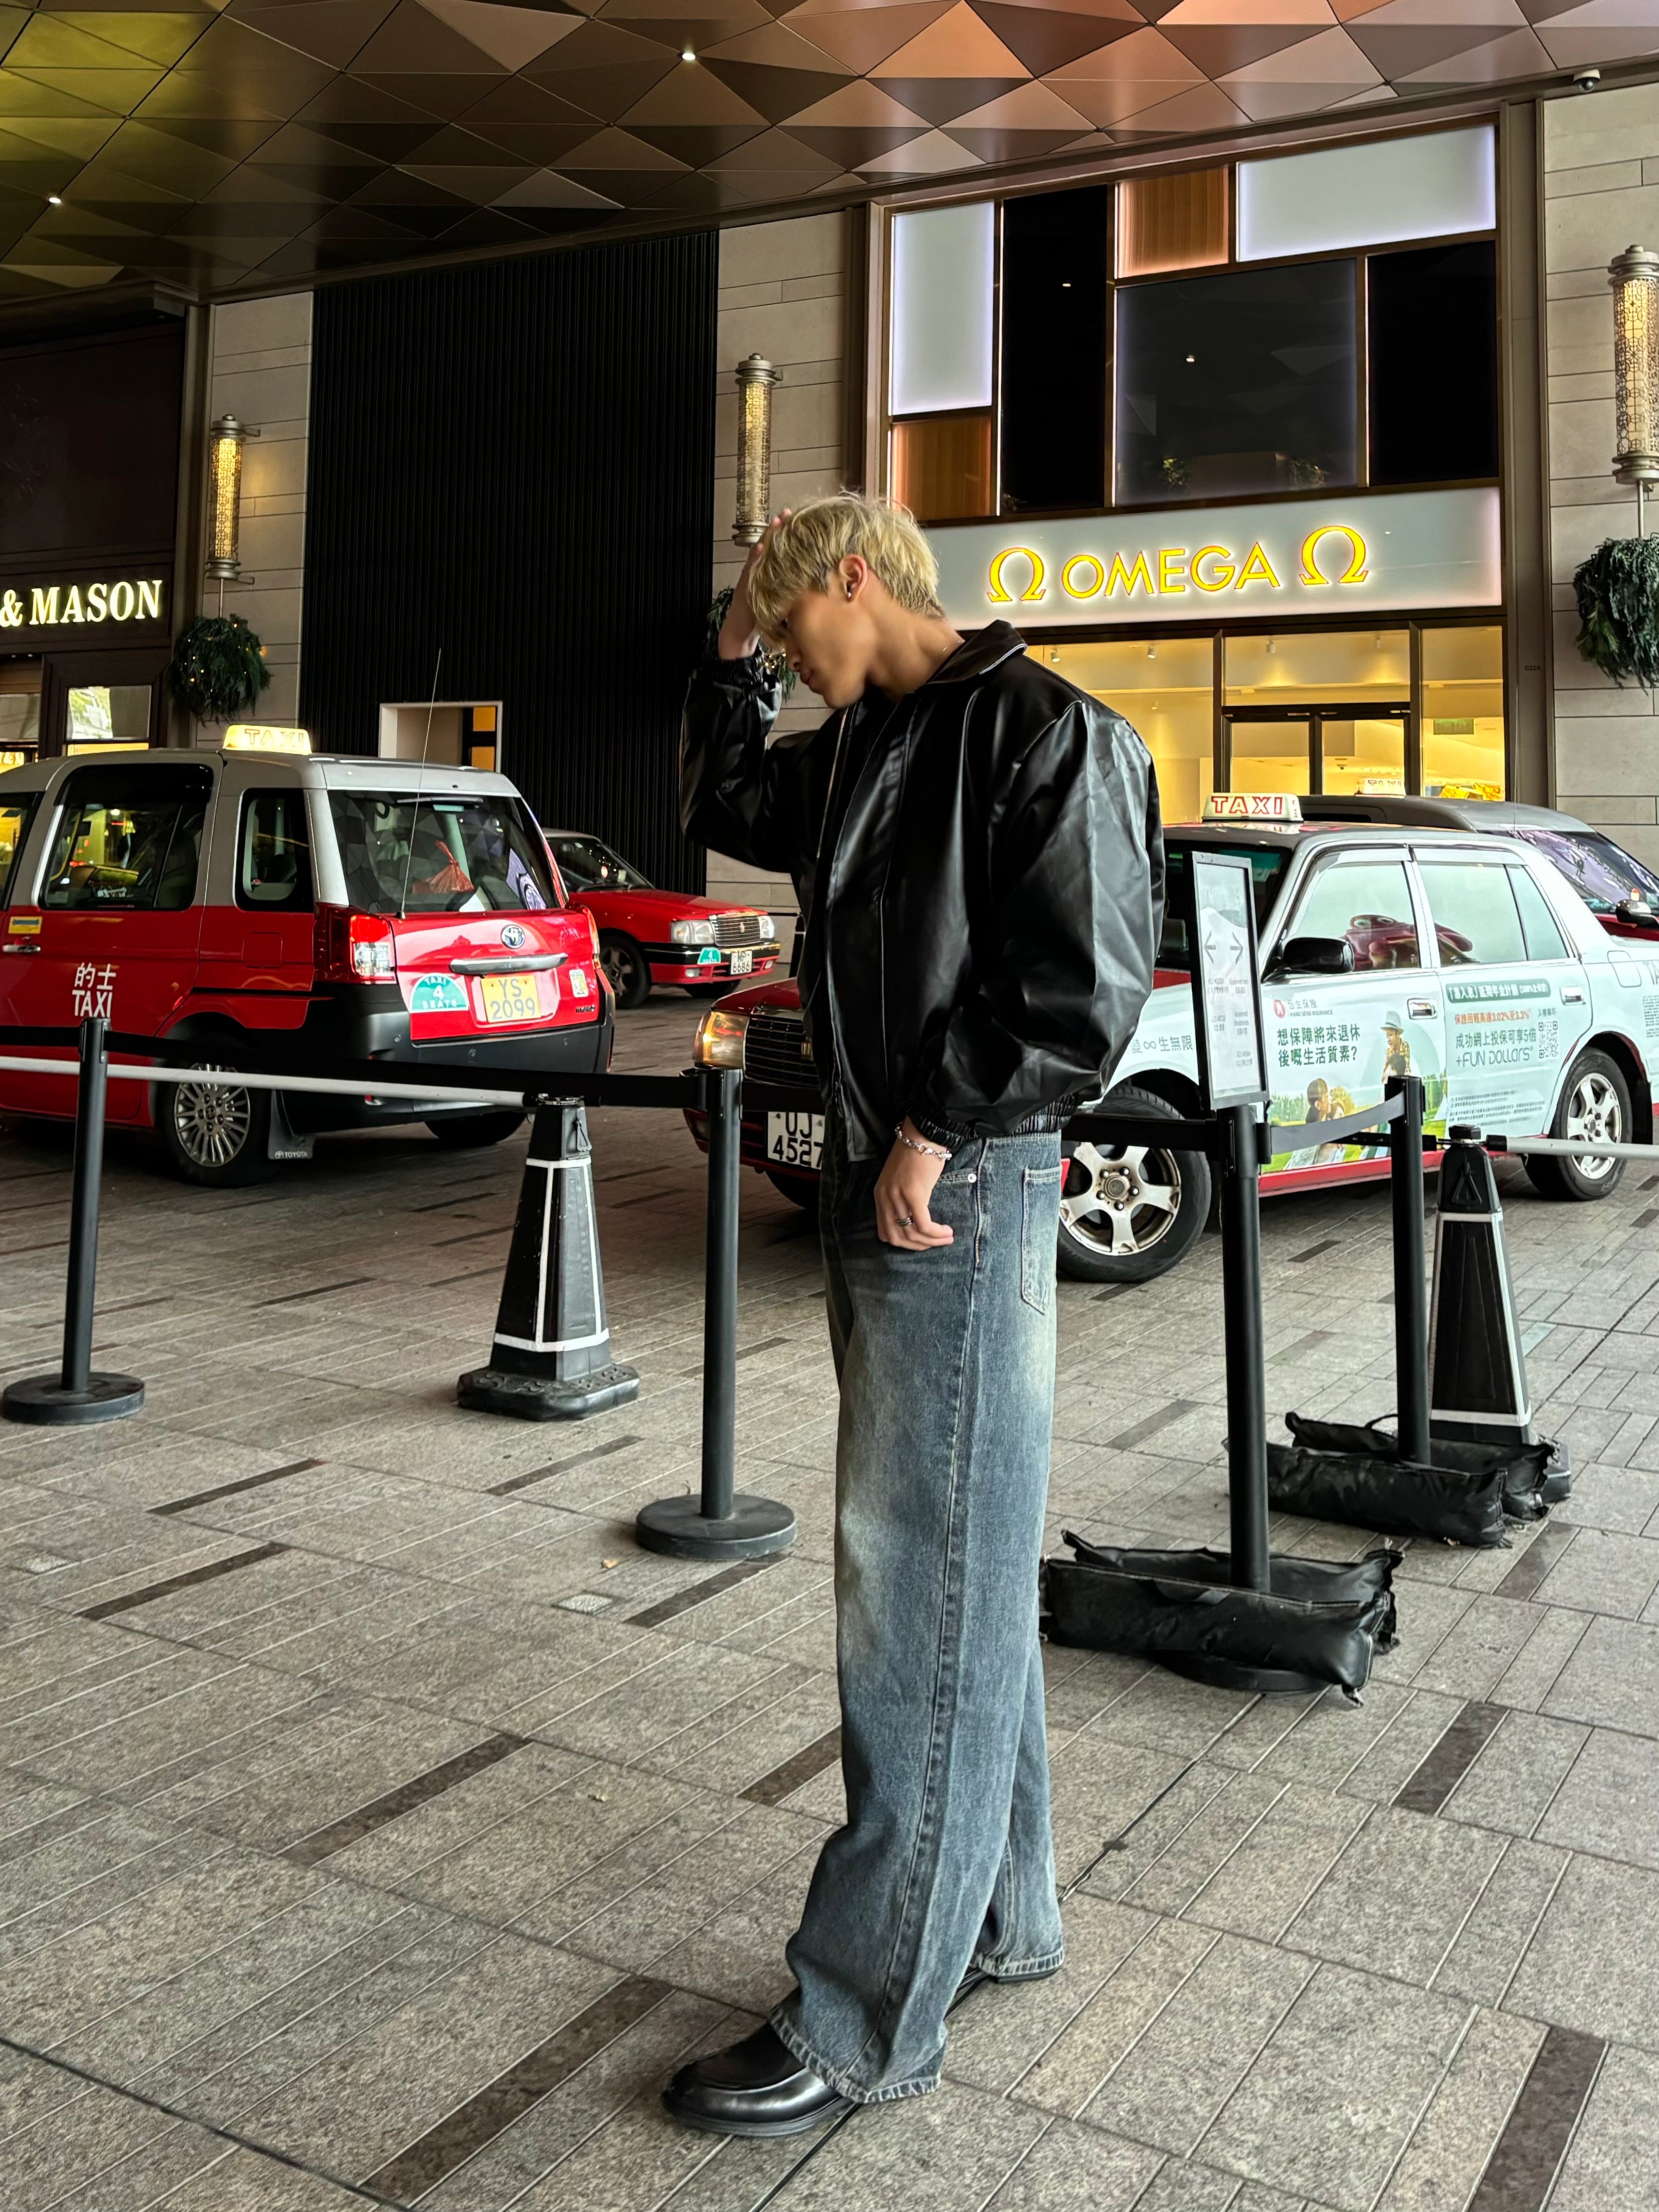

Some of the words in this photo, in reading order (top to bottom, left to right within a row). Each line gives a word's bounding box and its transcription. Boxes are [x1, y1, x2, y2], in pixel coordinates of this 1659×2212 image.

[1062, 541, 1280, 599] OMEGA
[0, 589, 23, 627] &
[29, 580, 163, 625] MASON
[244, 728, 304, 748] TAXI
[1211, 796, 1283, 815] TAXI
[74, 962, 116, 990] 的士
[733, 961, 749, 973] 6686
[424, 976, 446, 986] TAXI
[433, 984, 444, 1000] 4
[498, 978, 522, 999] YS
[72, 989, 113, 1018] TAXI
[490, 997, 535, 1020] 2099
[1277, 1023, 1360, 1046] 想保障將來退休
[1456, 1027, 1536, 1049] 成功網上投保可享5倍
[1278, 1045, 1357, 1067] 後嘅生活質素?
[785, 1112, 812, 1139] UJ
[772, 1135, 824, 1168] 4527
